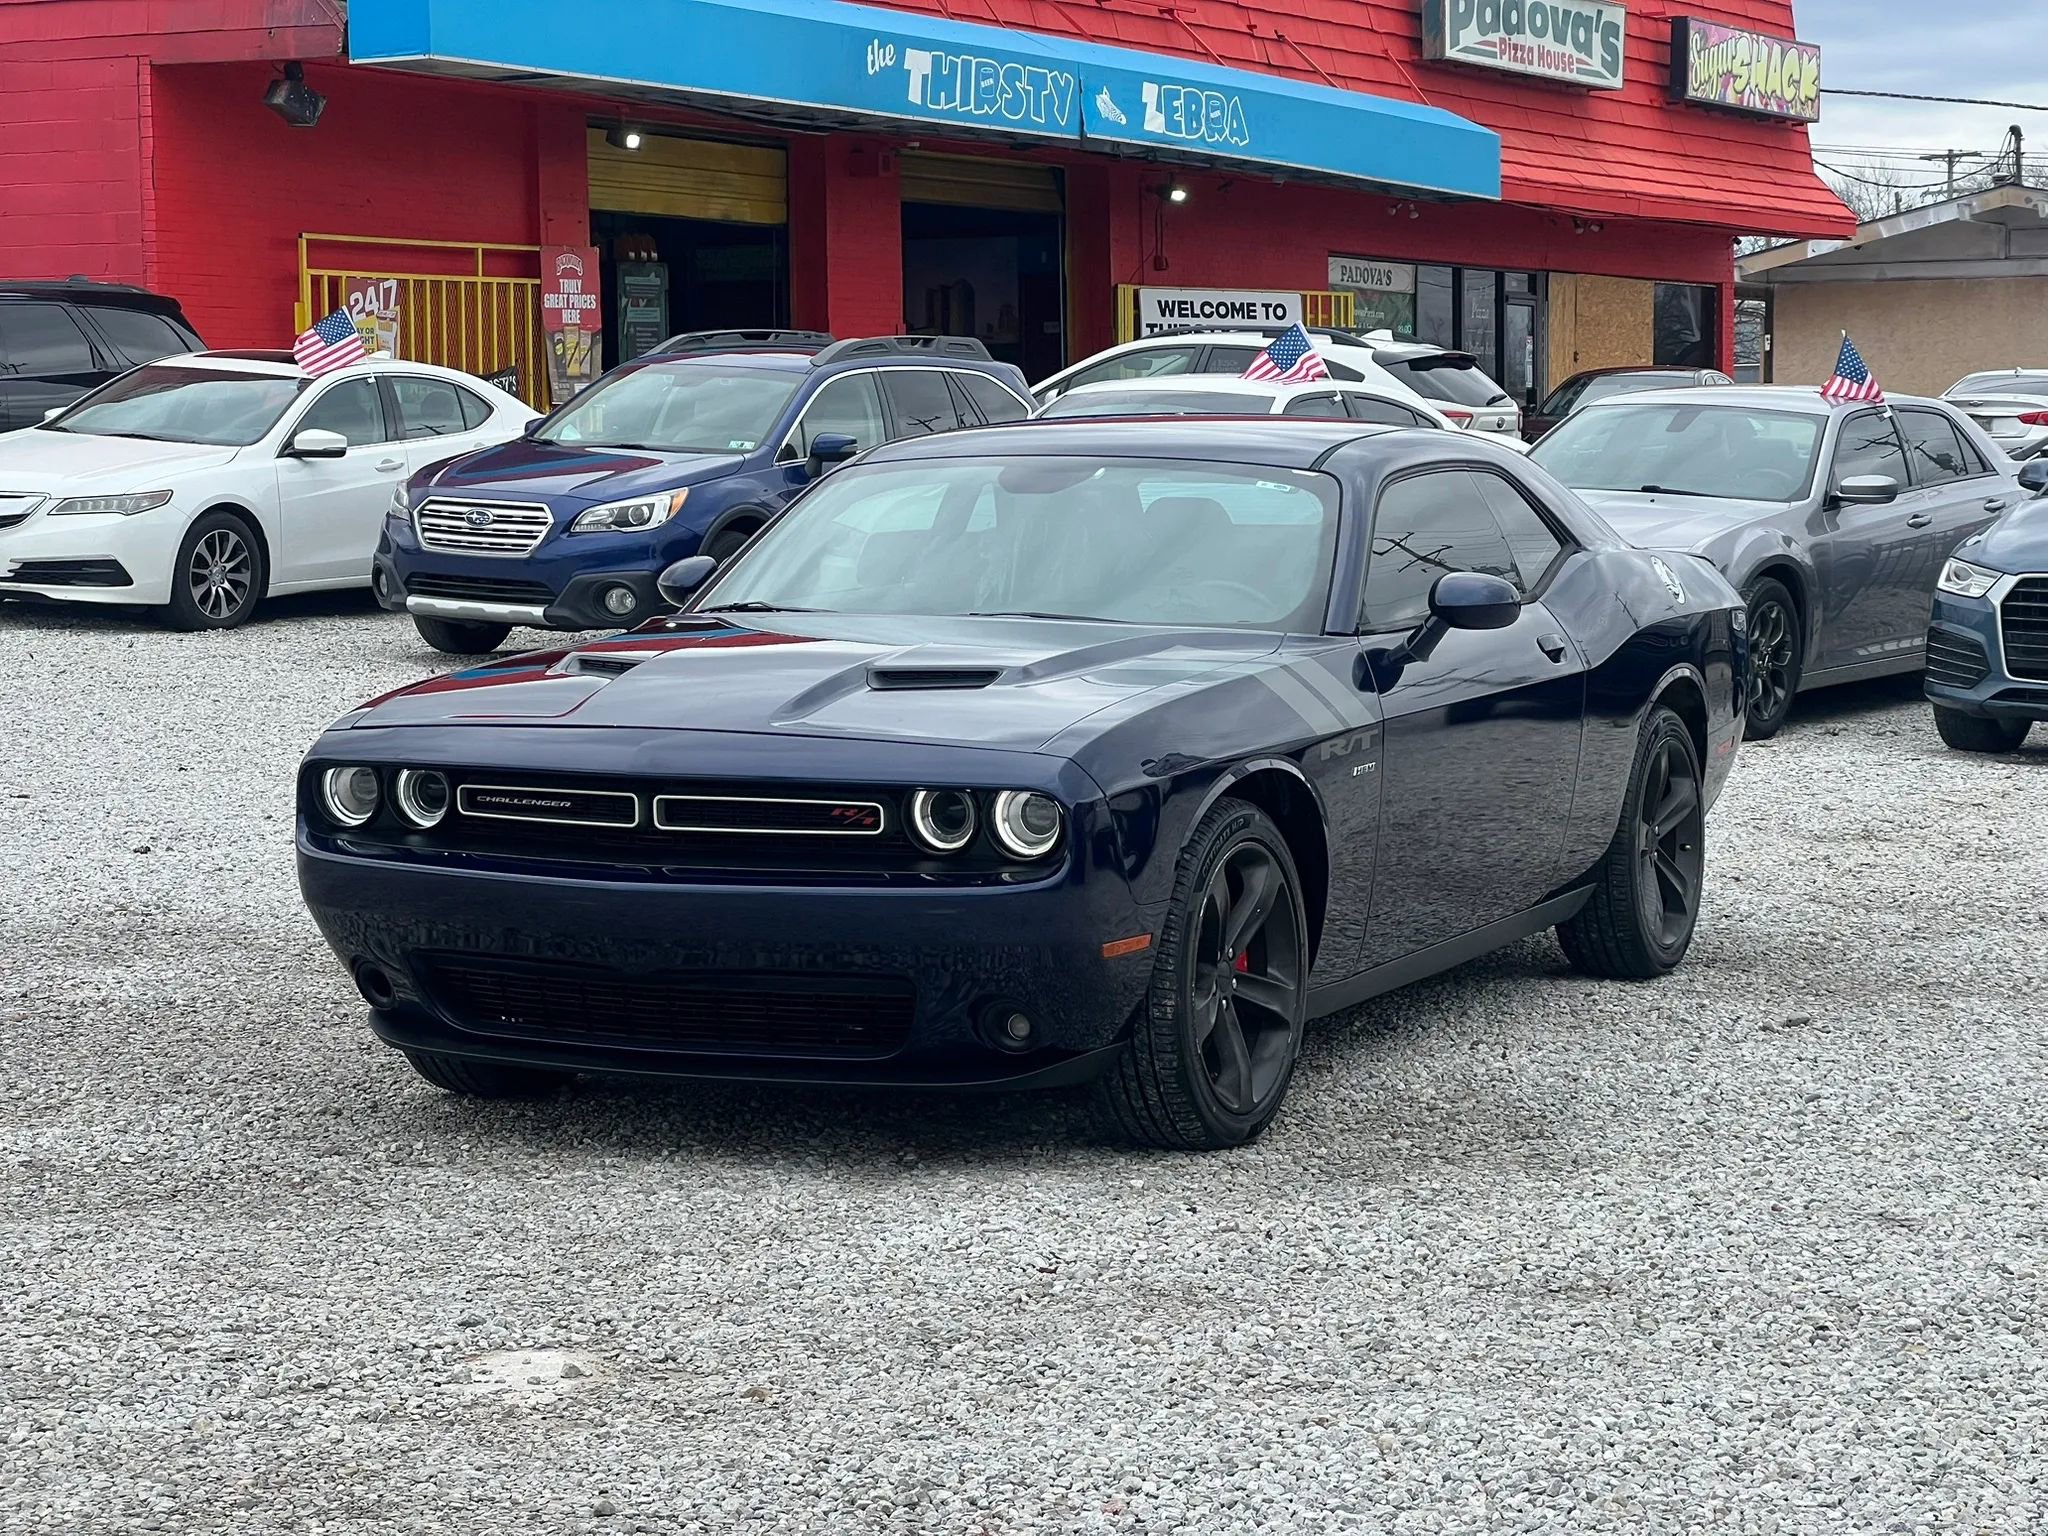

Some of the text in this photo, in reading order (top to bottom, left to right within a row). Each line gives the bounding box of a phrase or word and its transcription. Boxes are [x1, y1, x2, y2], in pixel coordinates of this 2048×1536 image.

[1498, 37, 1575, 74] Pizza House
[1691, 31, 1820, 105] Sugar SHACK
[866, 38, 1250, 147] the THIRSTY ZEBRA
[1340, 264, 1393, 287] PADOVA'S
[559, 278, 582, 294] TRULY
[544, 293, 597, 309] GREAT PRICES
[1157, 300, 1288, 321] WELCOME TO
[562, 309, 581, 324] HERE
[365, 327, 375, 335] OR
[1320, 728, 1379, 761] R/T
[476, 795, 572, 808] CHALLENGER
[831, 808, 878, 826] R/T
